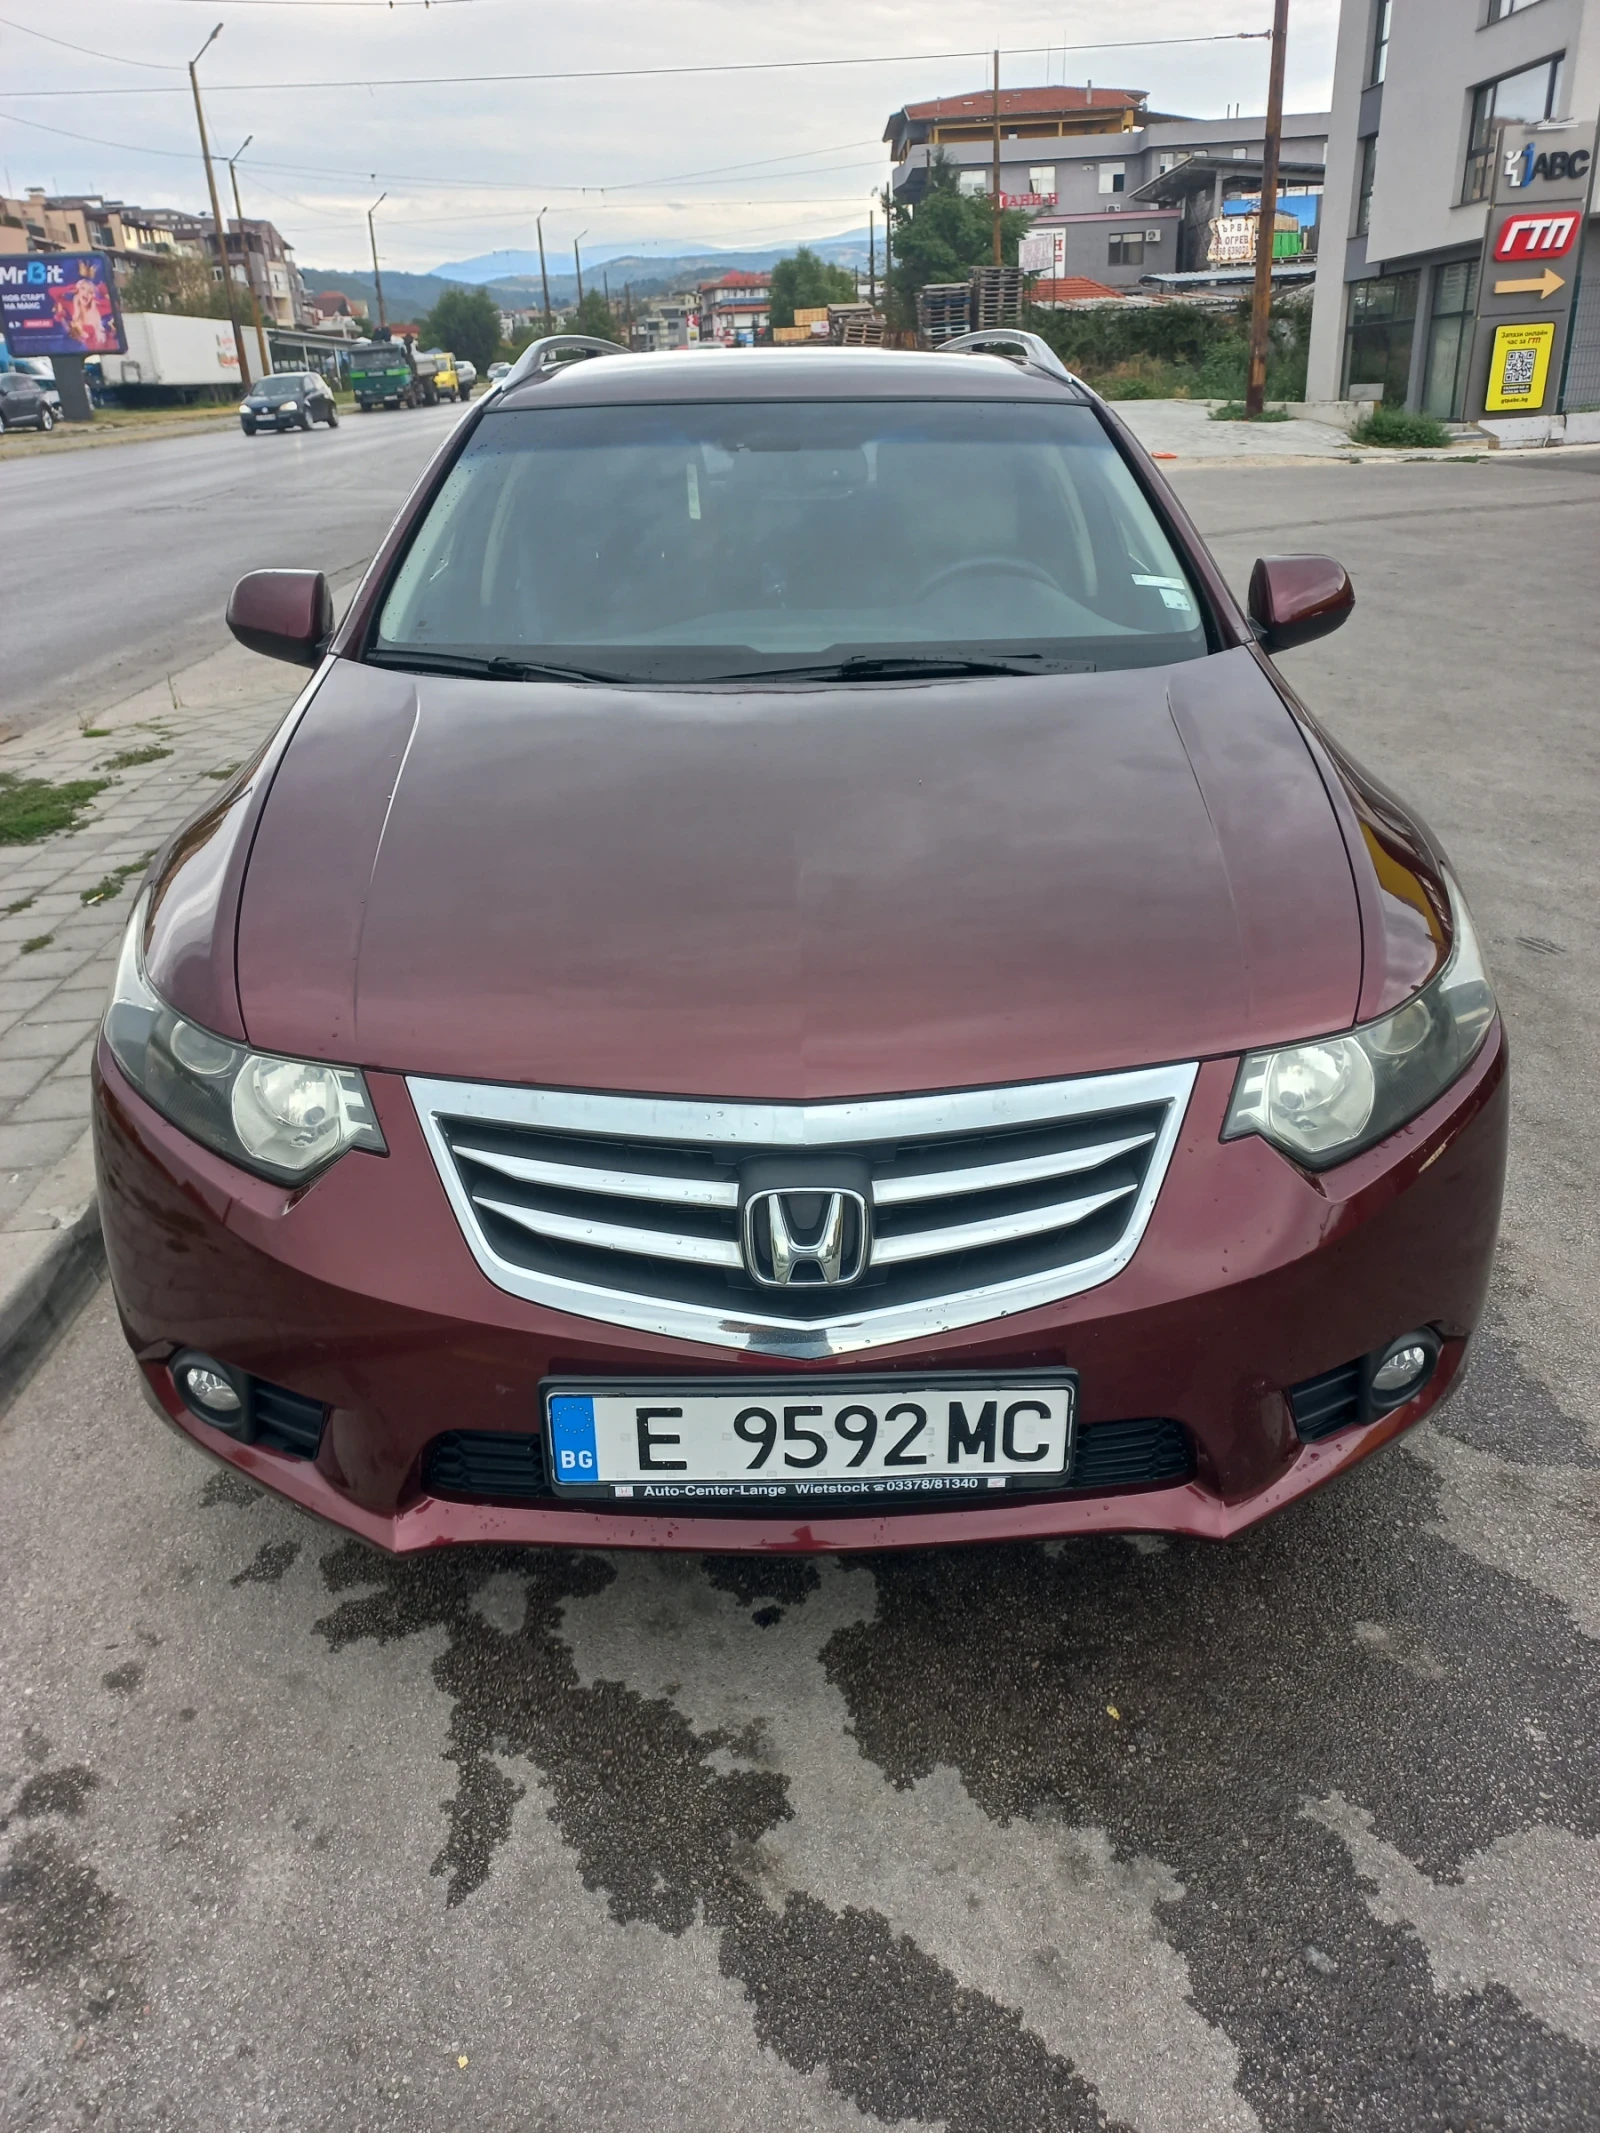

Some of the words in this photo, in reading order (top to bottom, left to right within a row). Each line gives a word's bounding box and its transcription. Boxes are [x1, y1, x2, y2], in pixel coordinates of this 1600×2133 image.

[1225, 235, 1249, 245] ОГРЕВ
[1501, 217, 1576, 252] ГТП
[0, 261, 64, 284] MrBit
[20, 293, 45, 301] СТАРТ
[636, 1407, 687, 1470] E
[733, 1402, 928, 1470] 9592
[947, 1400, 1051, 1463] MC
[560, 1450, 593, 1469] BG
[643, 1484, 787, 1497] Auto-Center-Lange
[795, 1482, 870, 1495] Wietstock
[886, 1477, 978, 1491] 03378/81340
